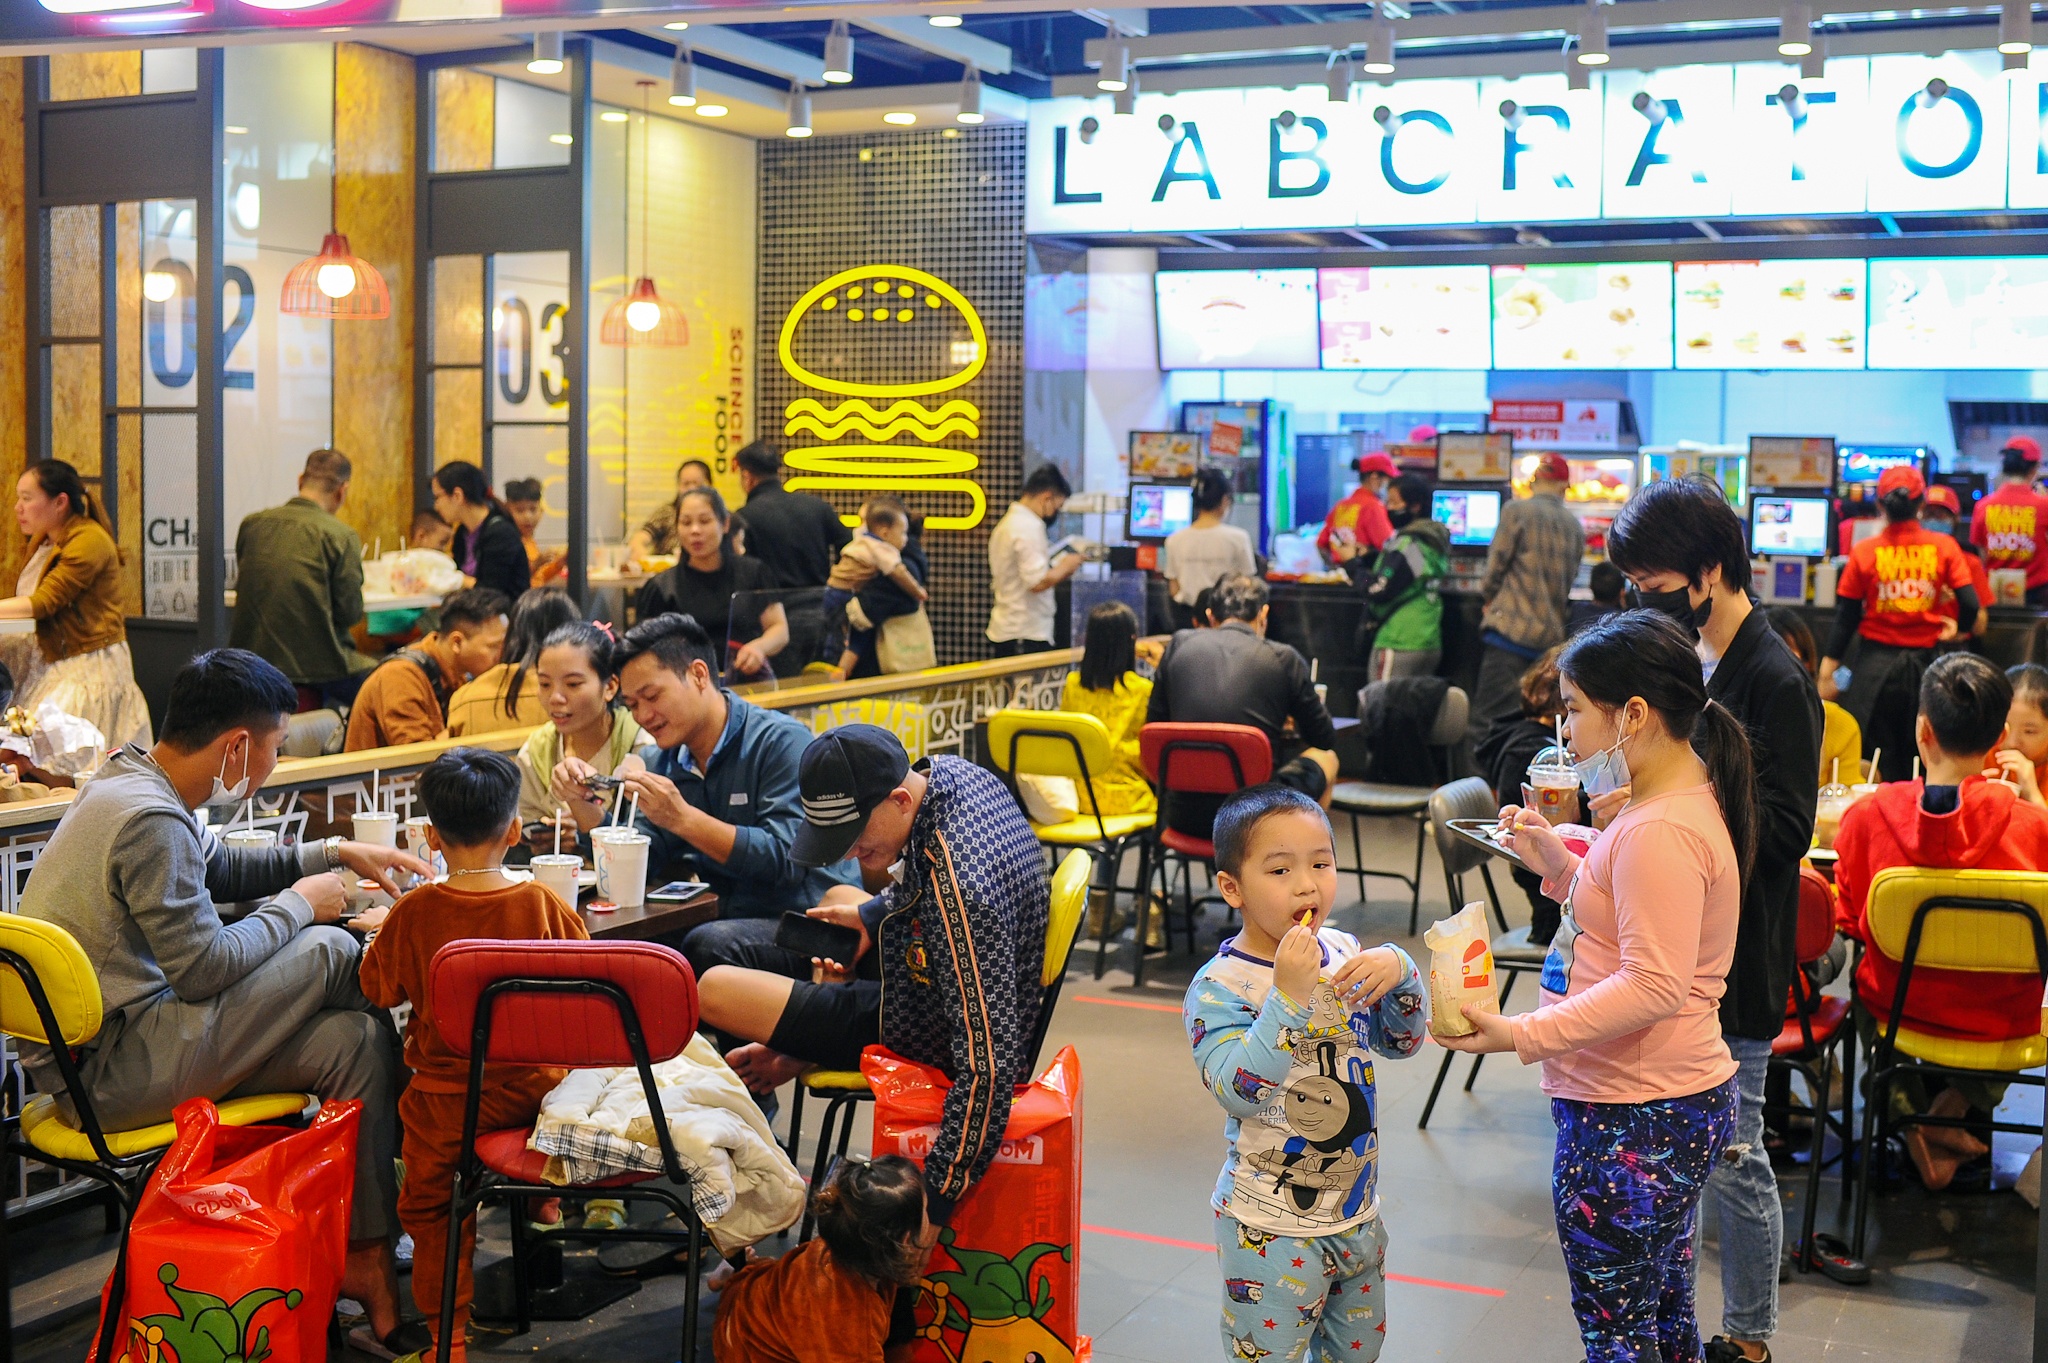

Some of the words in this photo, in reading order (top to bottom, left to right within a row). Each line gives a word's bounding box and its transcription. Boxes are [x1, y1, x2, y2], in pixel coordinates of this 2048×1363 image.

[500, 298, 569, 407] 03
[730, 328, 743, 443] SCIENCE
[715, 397, 727, 474] FOOD
[816, 793, 837, 801] adidas
